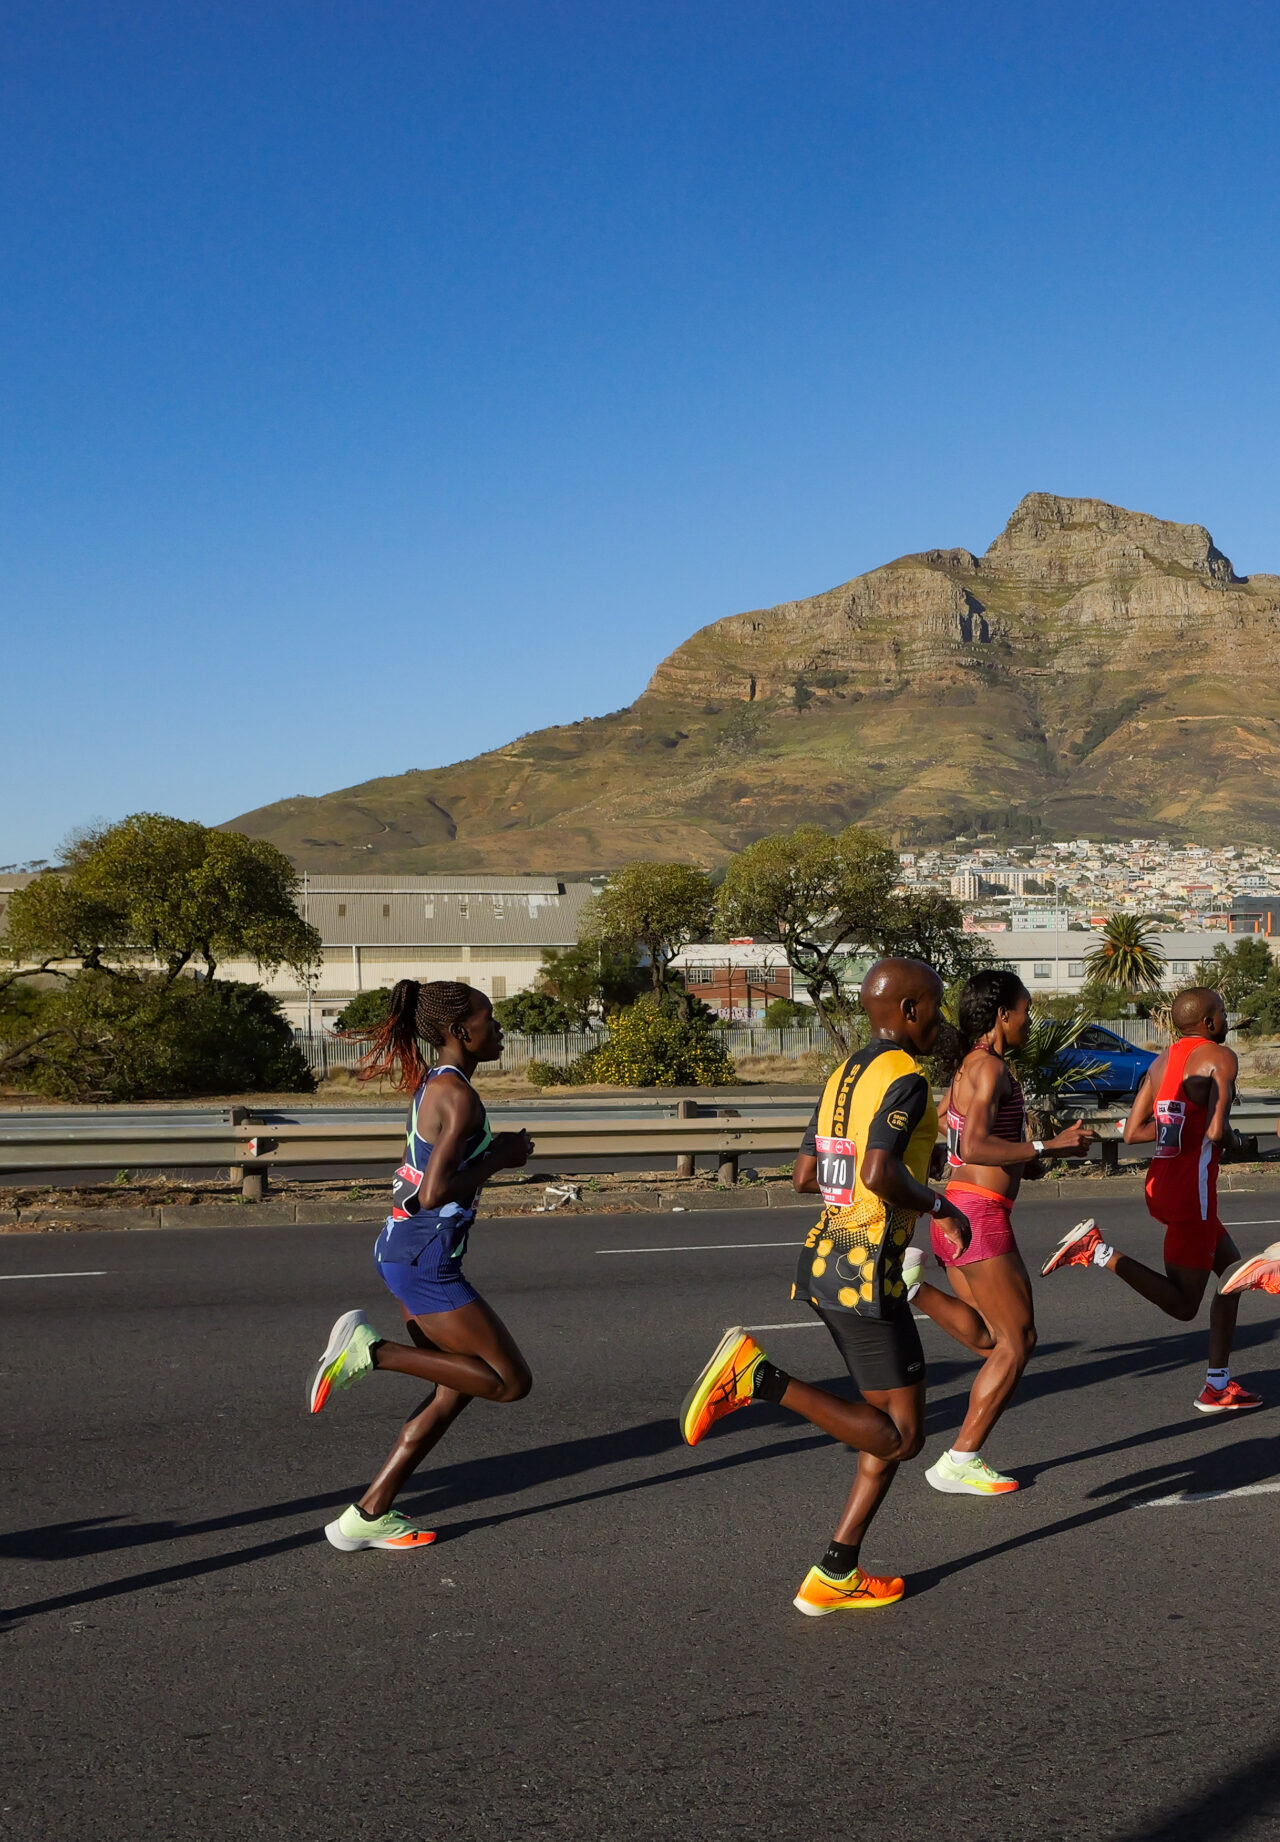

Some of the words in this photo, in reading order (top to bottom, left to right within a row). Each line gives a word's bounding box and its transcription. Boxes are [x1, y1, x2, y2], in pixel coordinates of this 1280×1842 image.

[833, 1062, 861, 1138] oberts
[1160, 1126, 1167, 1144] 2
[821, 1158, 847, 1186] 110
